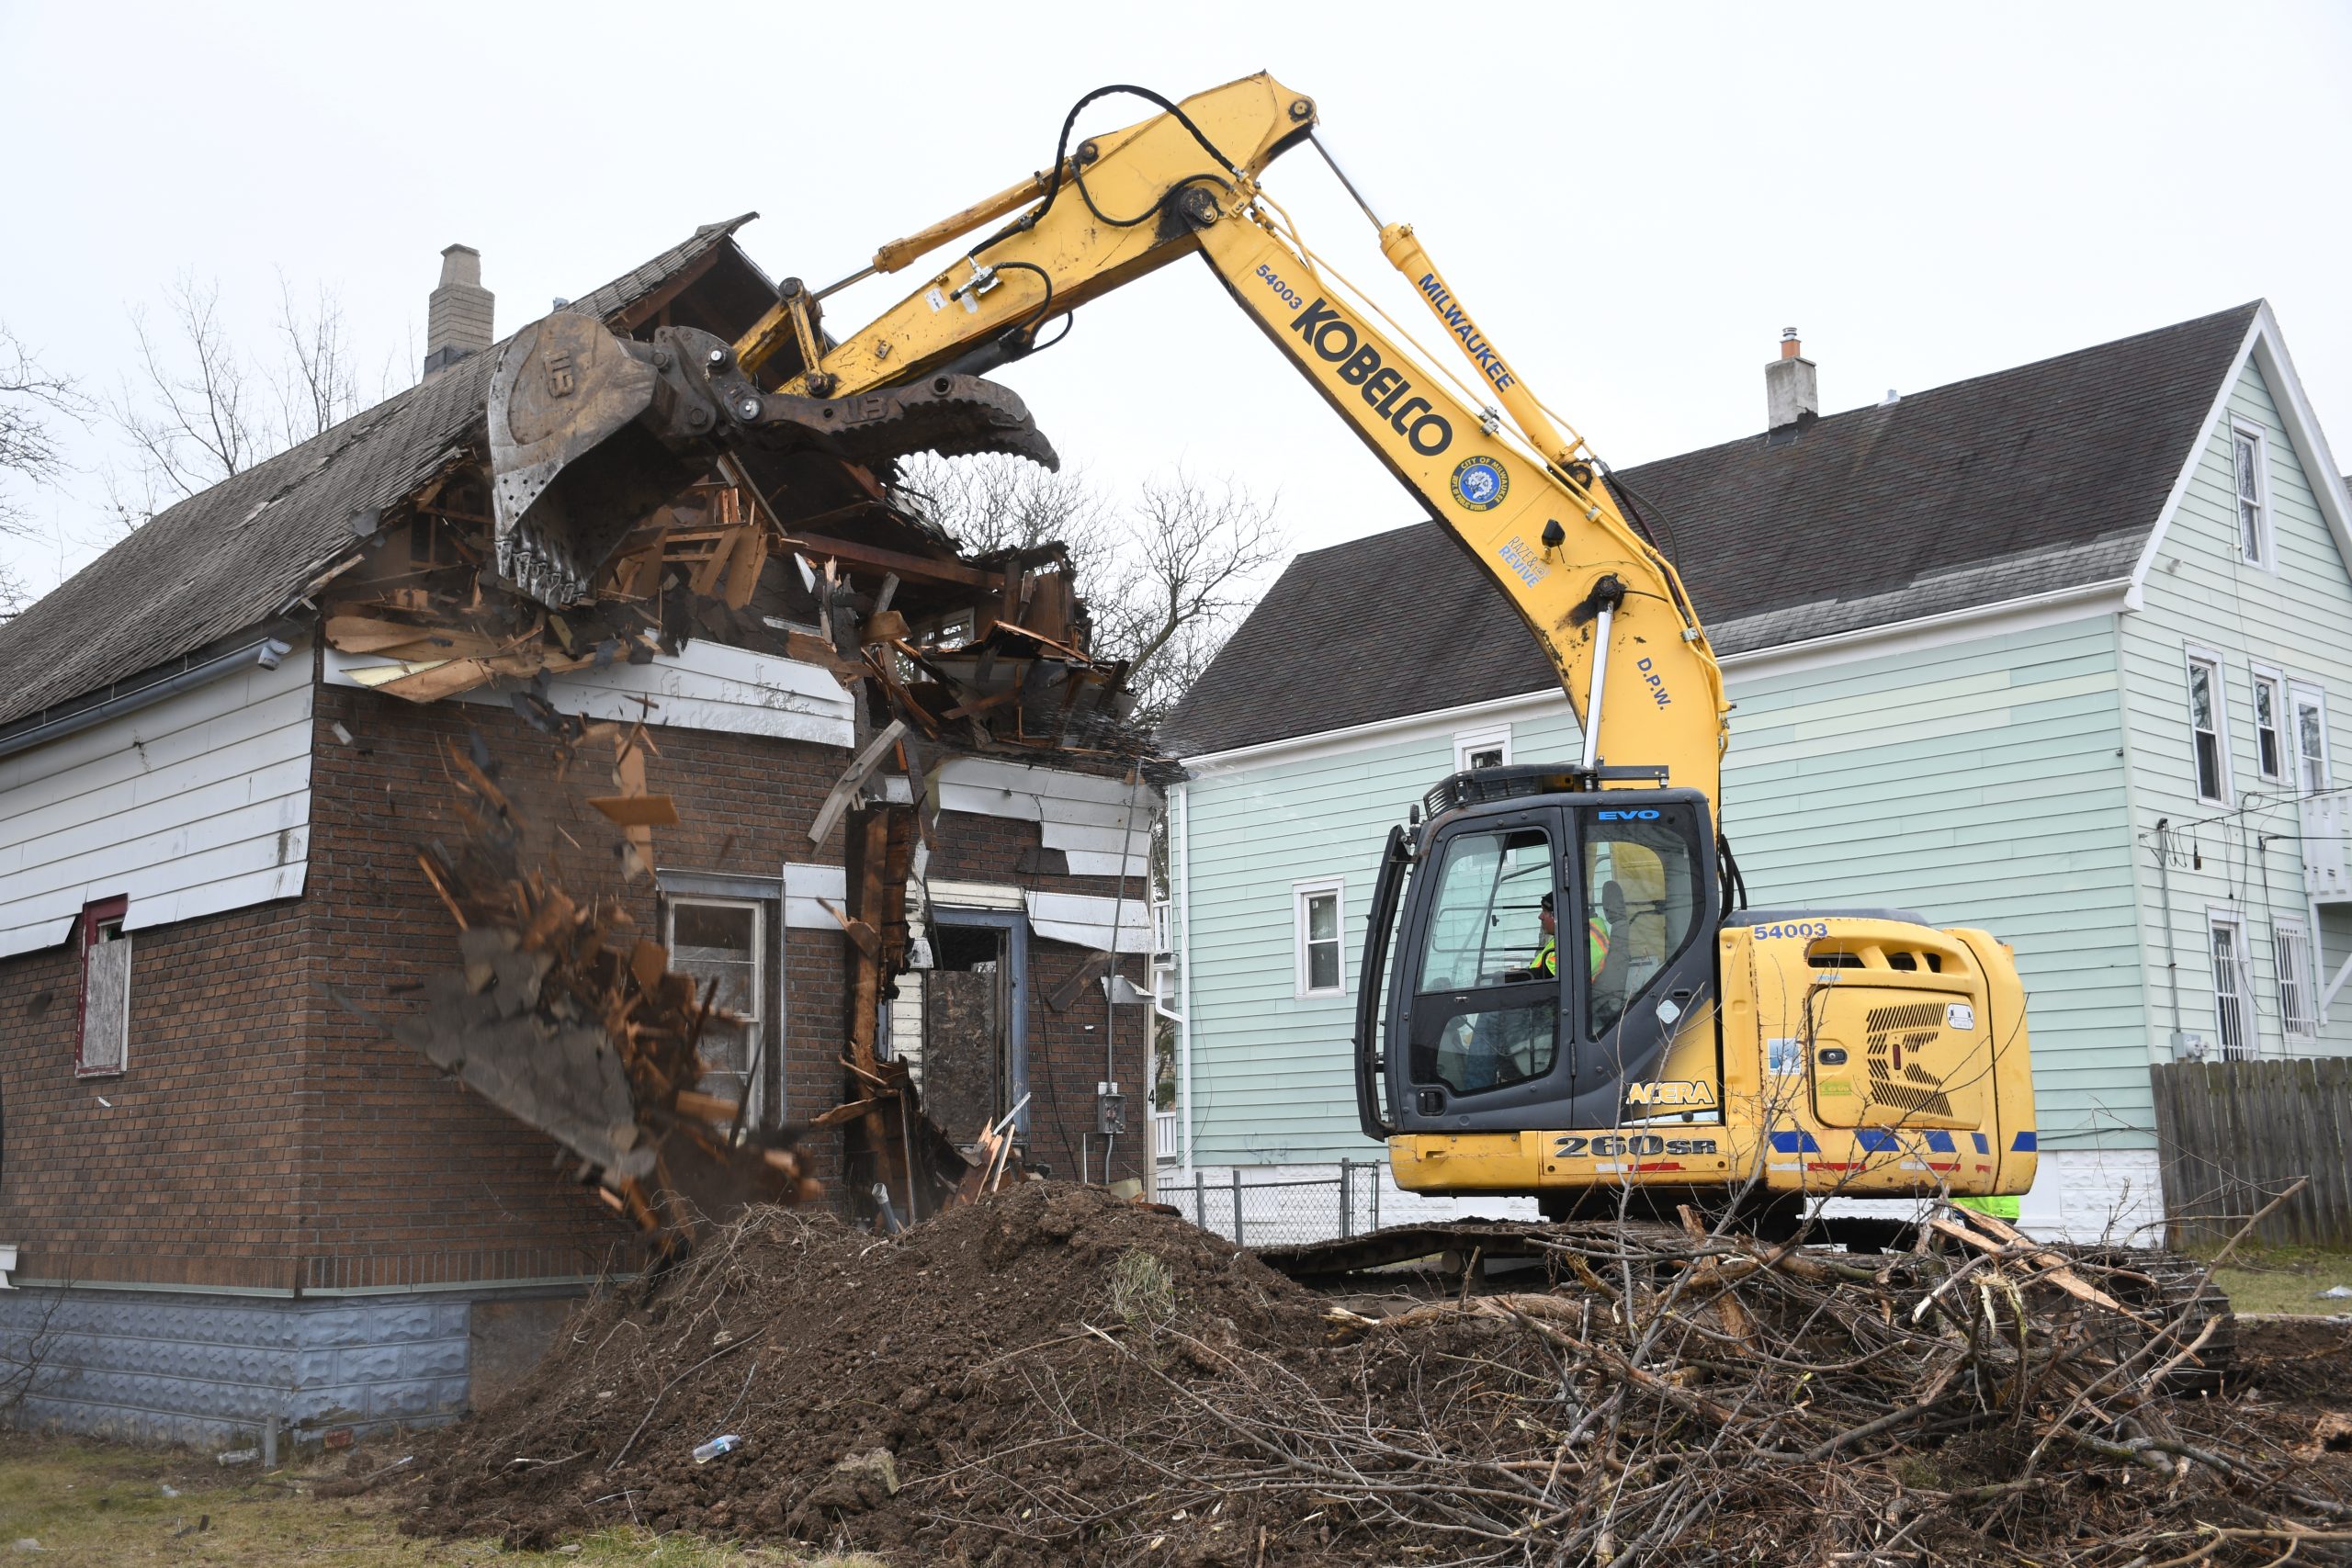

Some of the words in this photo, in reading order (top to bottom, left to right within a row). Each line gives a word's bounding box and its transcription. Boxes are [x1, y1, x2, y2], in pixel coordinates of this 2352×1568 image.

[1256, 264, 1303, 310] 54003
[1418, 273, 1515, 393] MILWAUKEE
[1289, 297, 1453, 457] KOBELCO
[1461, 457, 1476, 468] CITY
[1491, 461, 1508, 502] MILWAUKEE
[1498, 545, 1539, 588] REVIVE
[1636, 657, 1671, 710] D.P.W.
[1598, 809, 1660, 820] EVO
[1754, 922, 1828, 940] 54003
[1148, 1089, 1155, 1104] 4
[1625, 1080, 1715, 1105] ACERA
